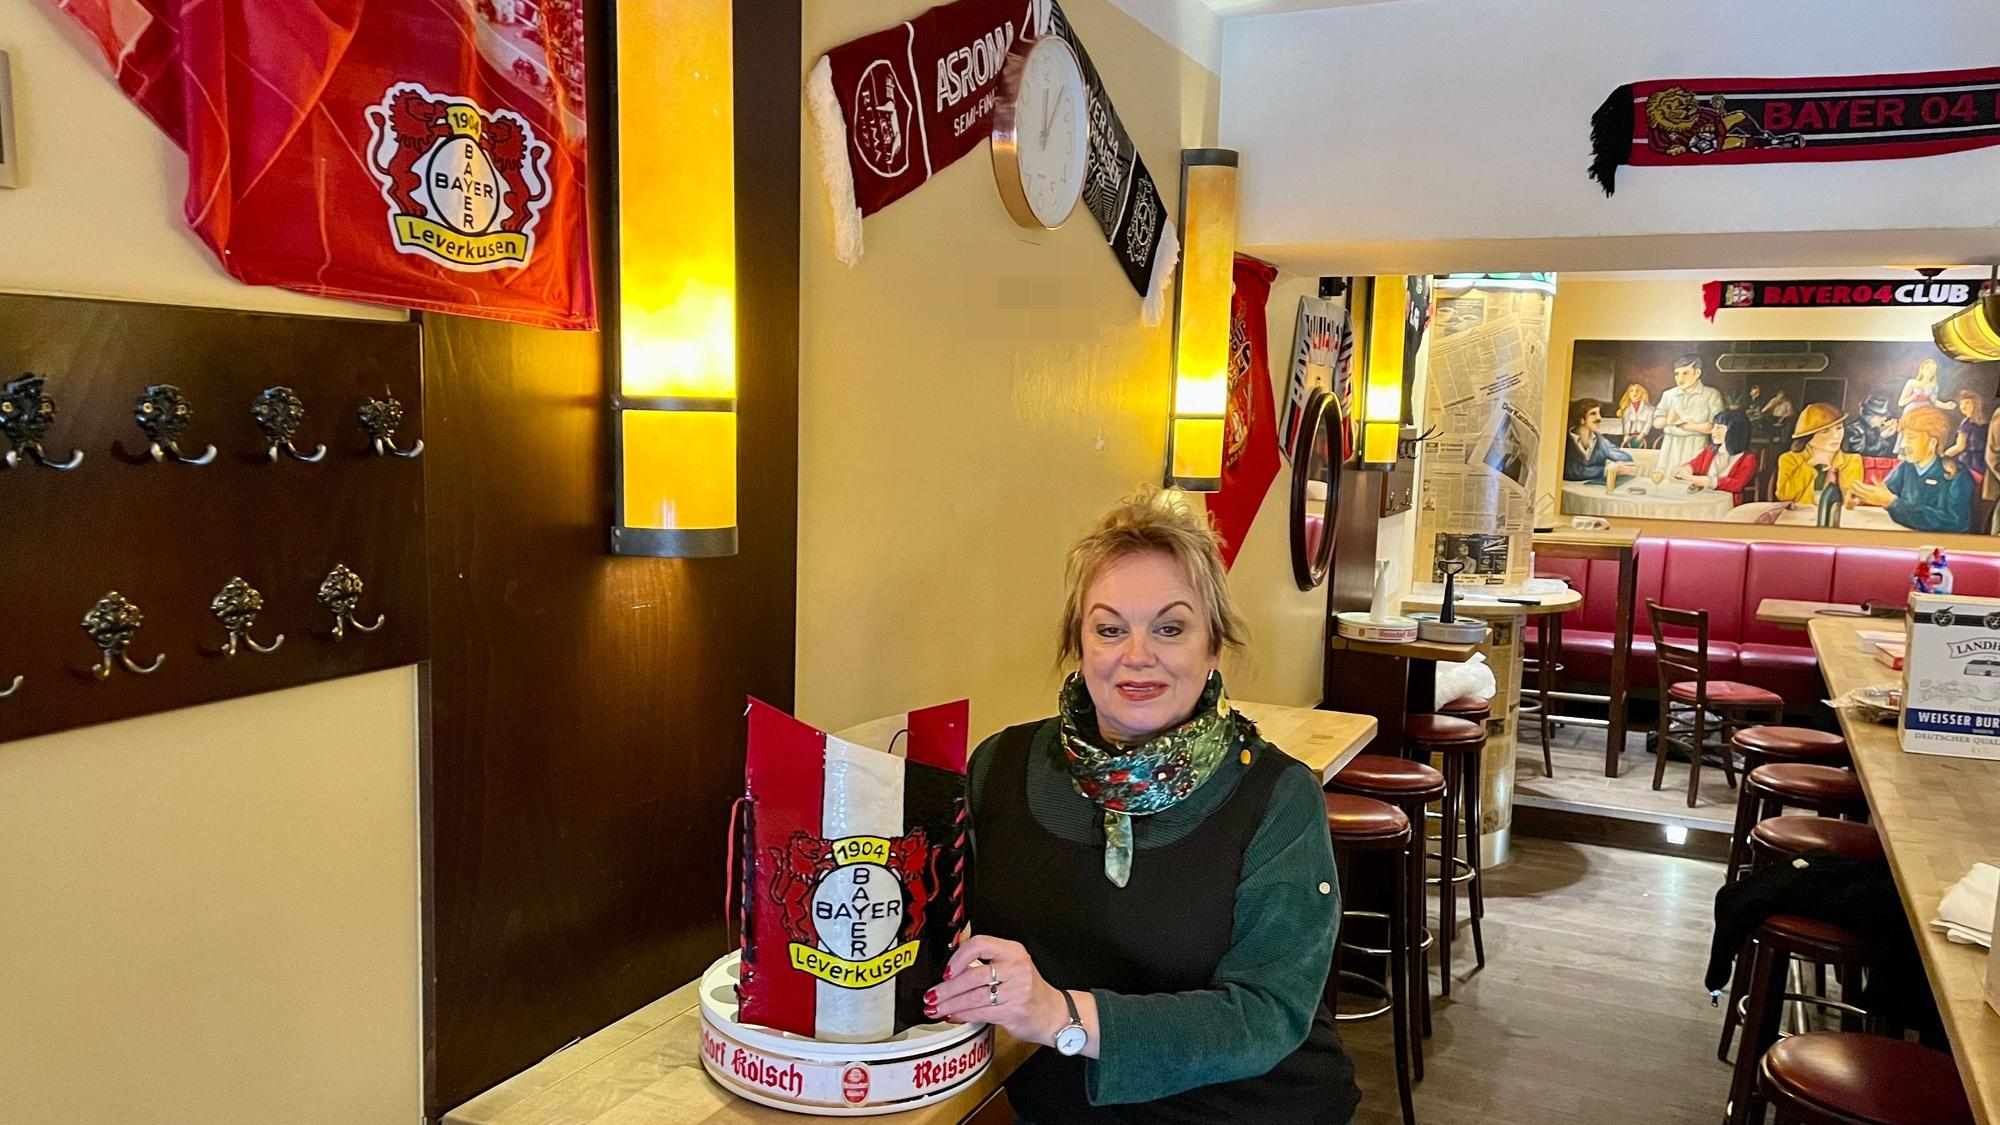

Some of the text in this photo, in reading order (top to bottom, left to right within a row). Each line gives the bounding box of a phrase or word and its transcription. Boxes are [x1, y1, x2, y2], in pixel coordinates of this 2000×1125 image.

[452, 112, 480, 136] 1904
[953, 87, 997, 137] SEMI-FIN
[1764, 98, 1905, 129] BAYER
[1920, 94, 1977, 124] 04
[435, 173, 494, 200] BAYER
[463, 144, 474, 229] BAYER
[408, 221, 517, 259] Leverkusen
[1918, 711, 2000, 728] WEISSER BUR
[1914, 732, 1970, 743] DEUTSCHER
[836, 841, 885, 859] 1904
[816, 900, 900, 920] BAYER
[851, 868, 870, 957] BAYER
[794, 950, 912, 982] Leverkusen
[731, 1048, 803, 1098] Kölsch
[912, 1029, 992, 1089] Reissdorf
